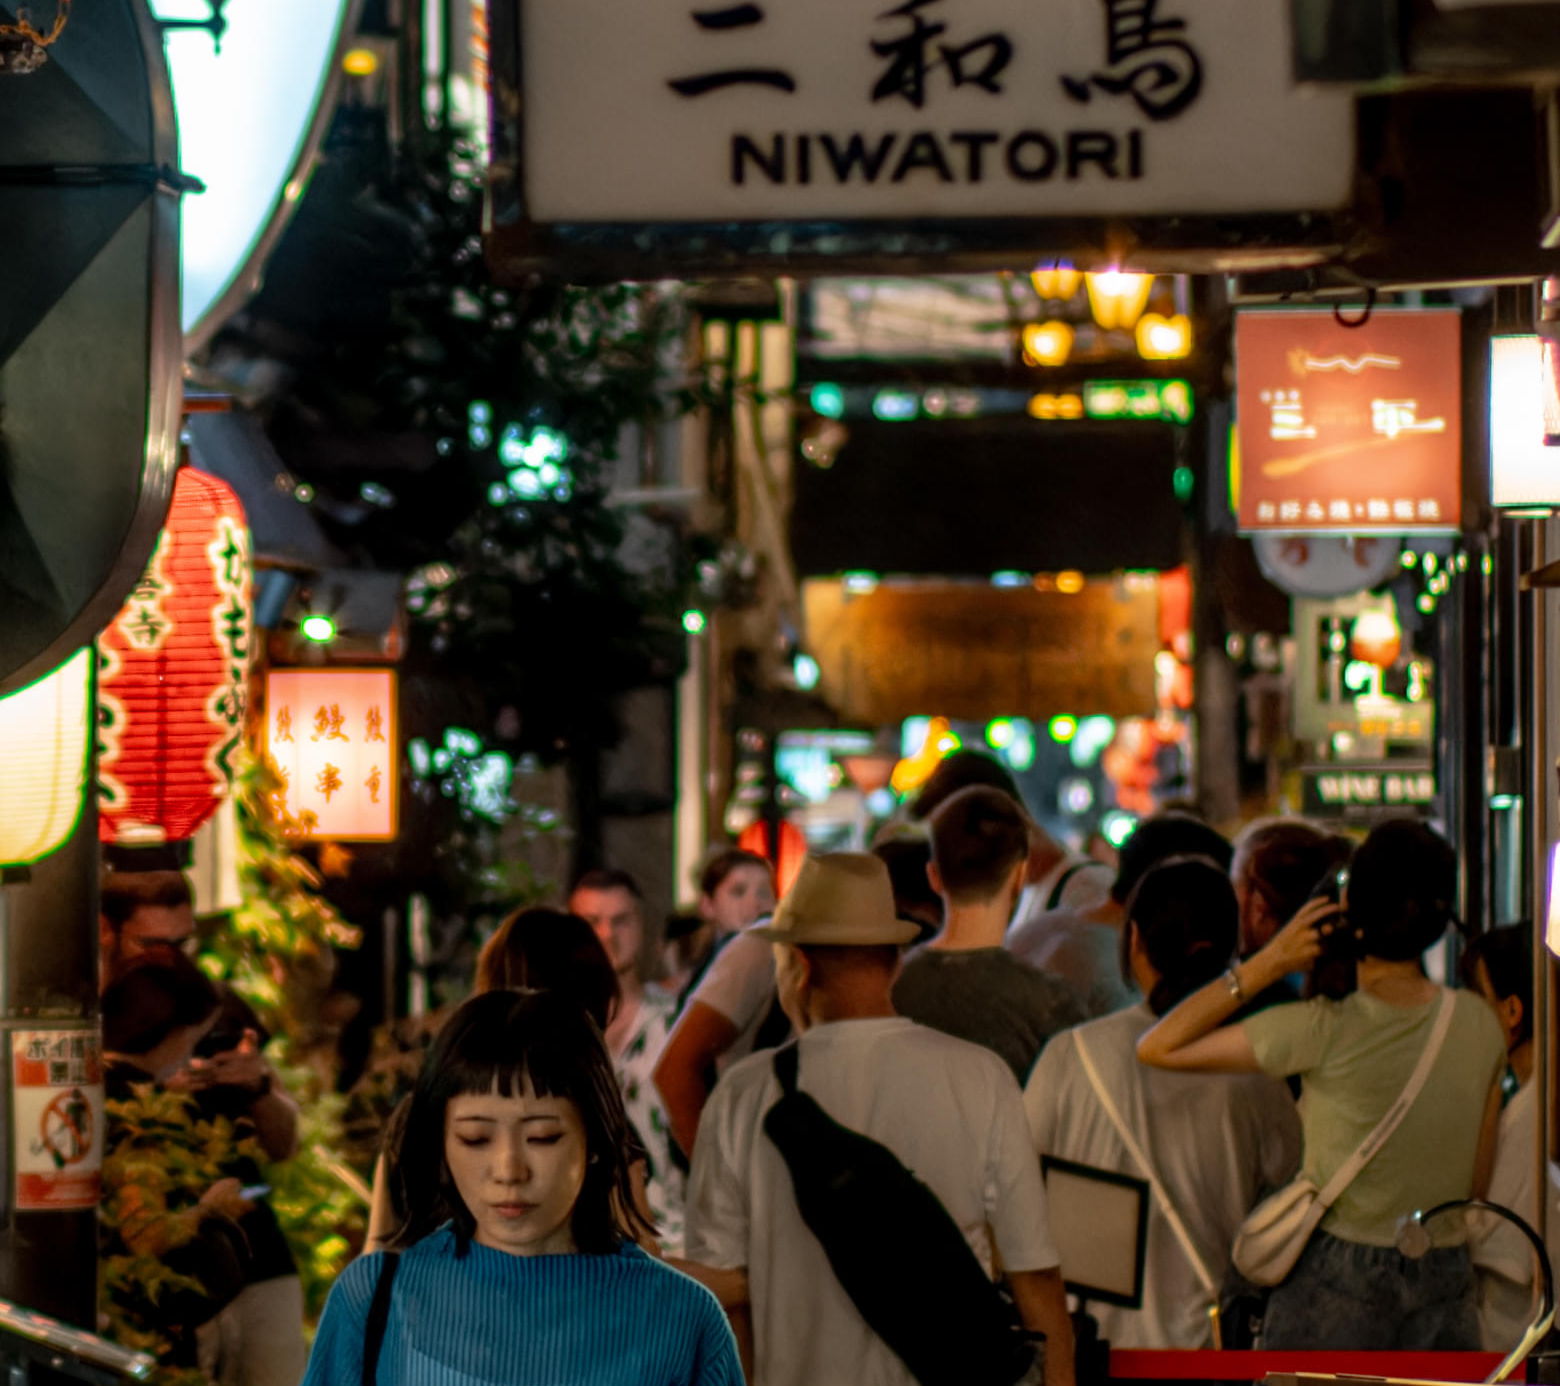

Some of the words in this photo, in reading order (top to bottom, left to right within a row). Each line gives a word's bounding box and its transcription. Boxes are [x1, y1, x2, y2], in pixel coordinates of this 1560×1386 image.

[729, 127, 1145, 186] NIWATORI
[1317, 774, 1380, 801] WINE
[1384, 774, 1435, 801] BAR
